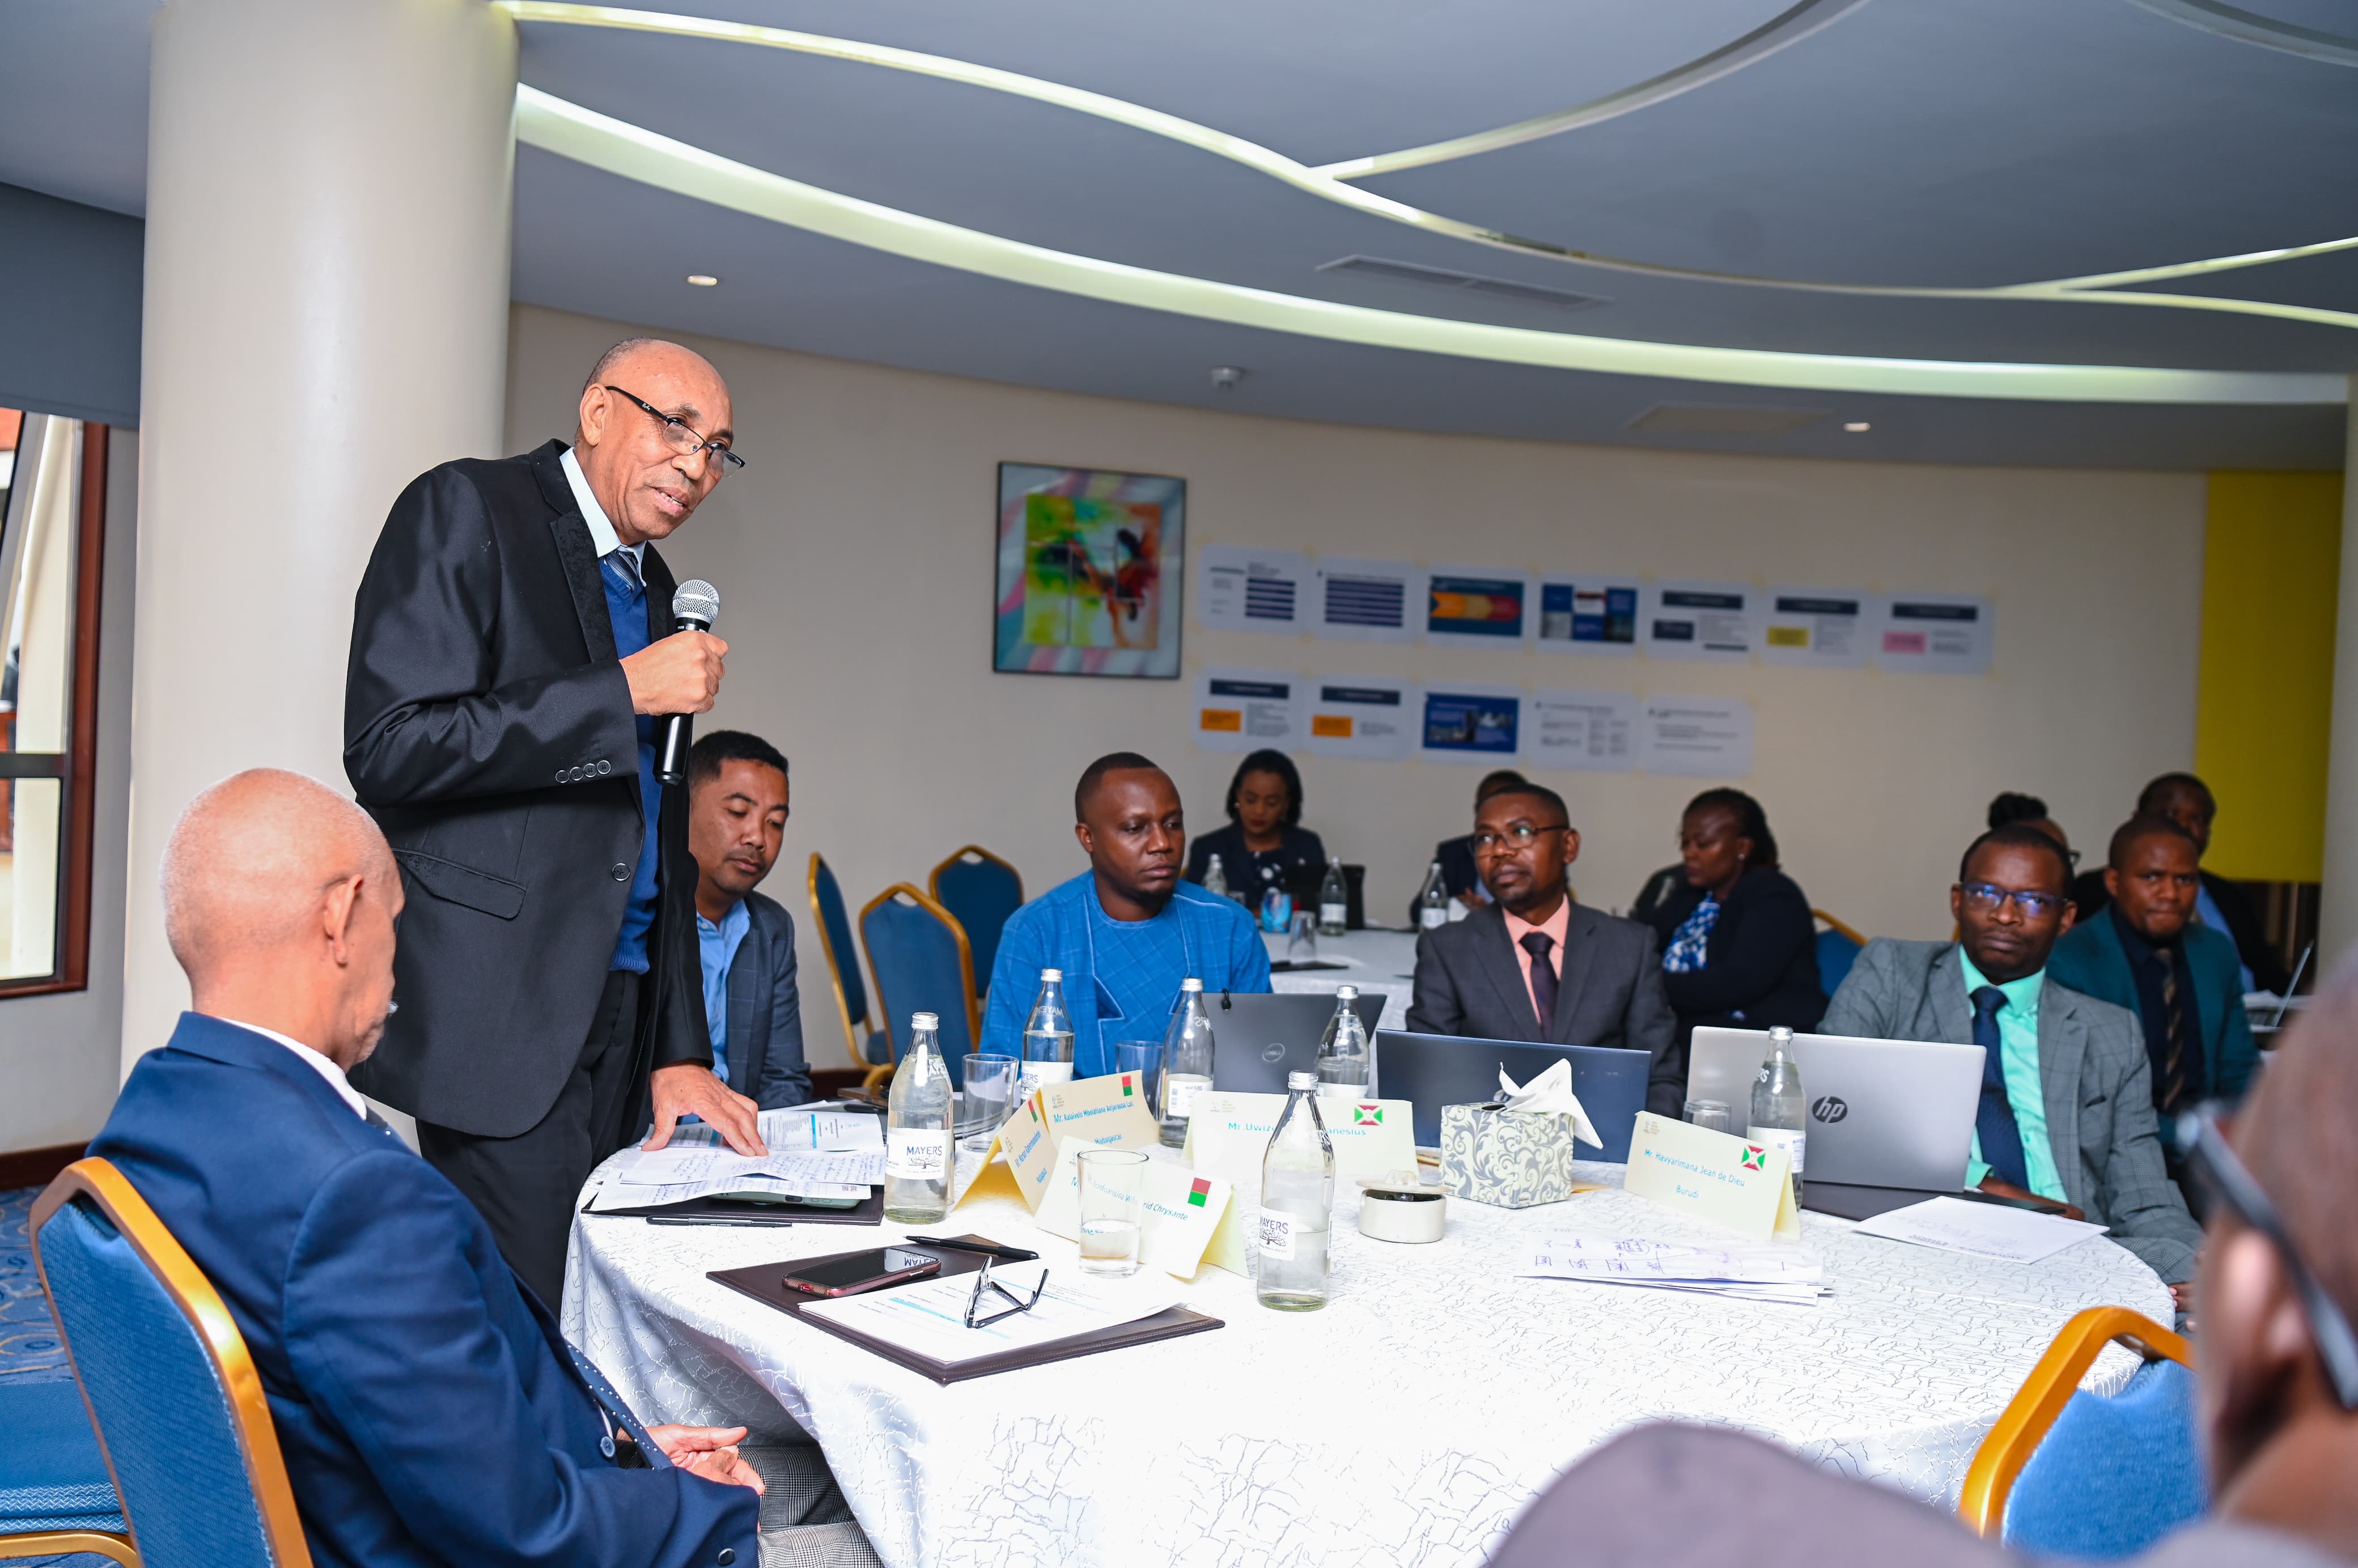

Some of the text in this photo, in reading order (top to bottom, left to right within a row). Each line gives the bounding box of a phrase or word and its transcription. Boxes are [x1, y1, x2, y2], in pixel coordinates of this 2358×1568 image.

[1815, 1096, 1845, 1123] hp
[1054, 1114, 1063, 1123] Mr.
[1094, 1134, 1122, 1145] Madagascar
[906, 1145, 942, 1156] MAYERS
[1644, 1148, 1653, 1157] Mr.
[1700, 1165, 1716, 1178] Jean
[1718, 1171, 1727, 1181] de
[1728, 1174, 1745, 1187] Dieu
[1676, 1184, 1699, 1199] Burudi
[1153, 1204, 1189, 1221] Chrysante
